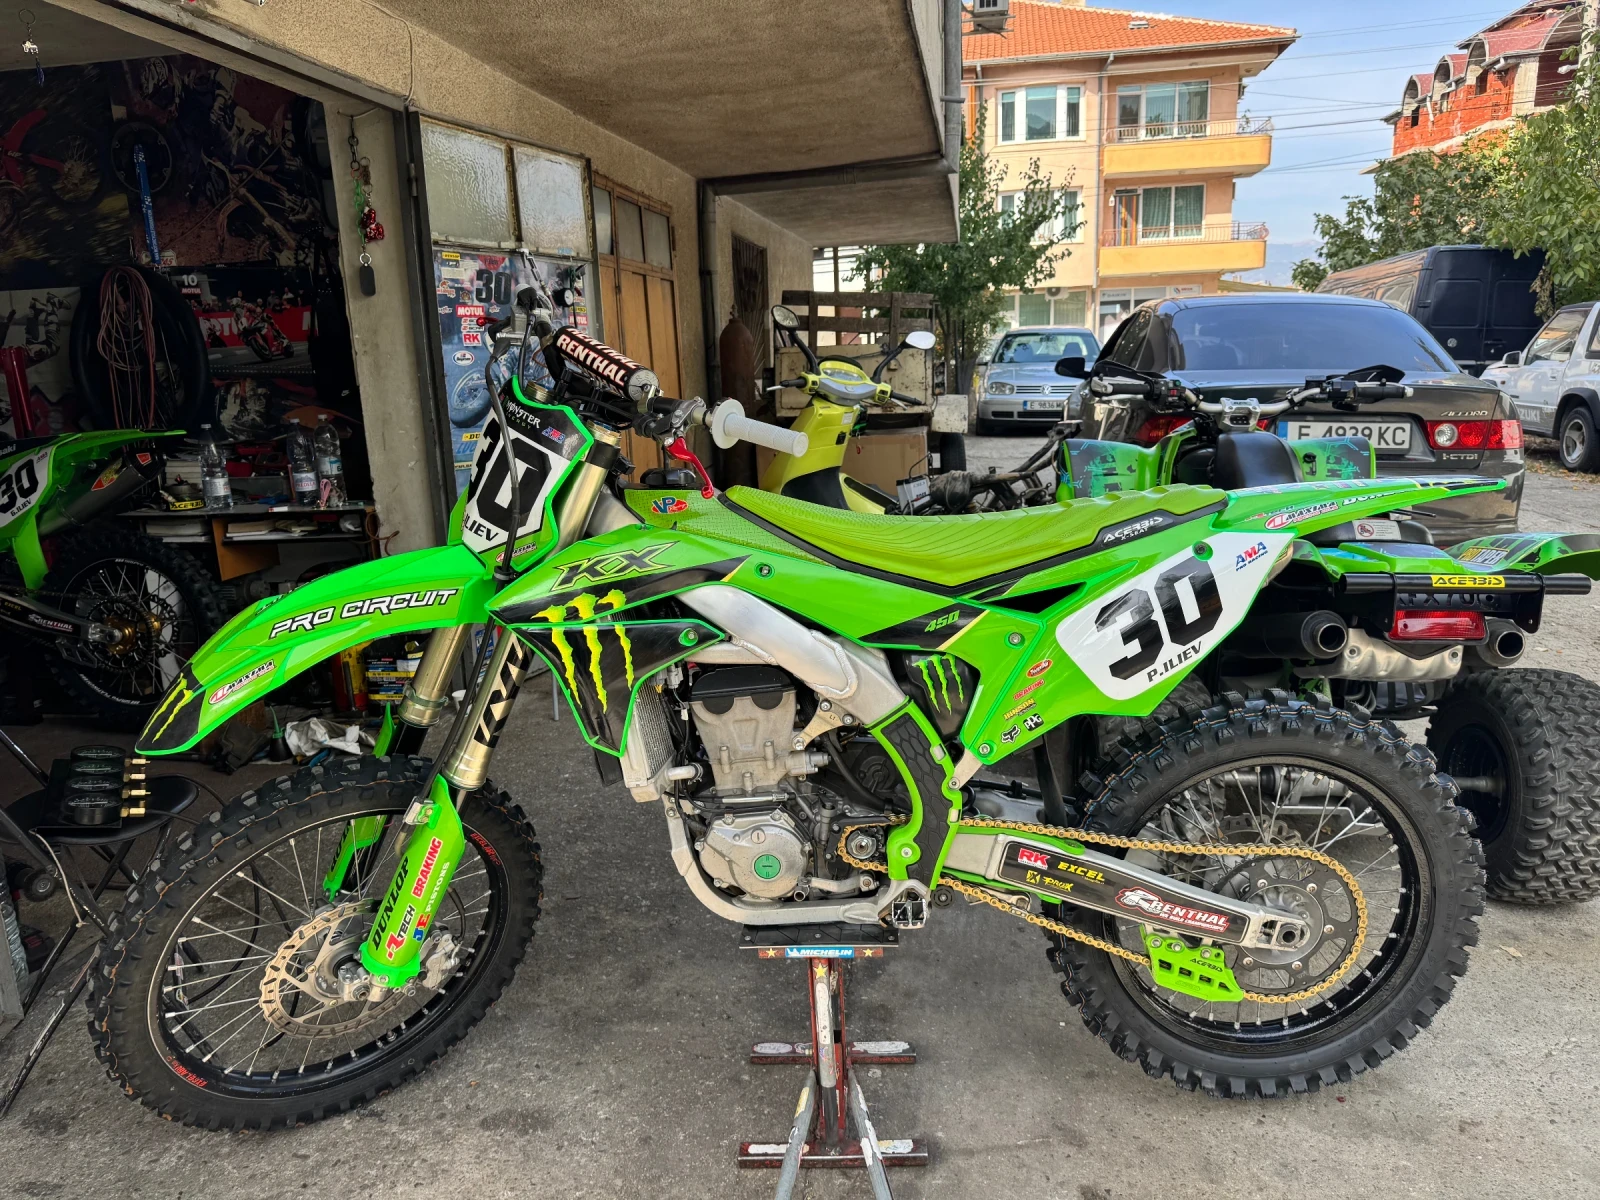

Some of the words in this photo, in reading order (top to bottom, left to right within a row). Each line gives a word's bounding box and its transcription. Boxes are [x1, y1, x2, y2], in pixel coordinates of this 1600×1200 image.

[182, 275, 198, 286] 10
[475, 269, 511, 305] 30
[457, 306, 484, 316] MOTUL
[569, 316, 587, 325] MTUL
[463, 333, 481, 343] RK
[556, 334, 627, 387] RENTHAL
[506, 400, 541, 429] MONSTER
[0, 458, 39, 514] 30
[651, 496, 676, 514] VP
[1285, 501, 1338, 522] MAXIMA
[1103, 516, 1164, 543] ACERBIS
[549, 540, 680, 592] KX
[1235, 541, 1267, 567] AMA
[1434, 577, 1503, 586] ACERBIS
[267, 606, 336, 640] PRO
[339, 588, 460, 620] CIRCUIT
[924, 609, 960, 633] 450
[1094, 556, 1223, 681] 30
[1146, 640, 1202, 683] P.ILIEV
[412, 836, 443, 899] BRAKING
[1018, 848, 1050, 867] RK
[1057, 861, 1106, 882] EXCEL
[425, 861, 450, 912] PISTONS
[372, 855, 410, 951] DUNLOP
[1150, 900, 1227, 926] RENTHAL
[412, 913, 432, 942] JE
[1190, 957, 1223, 973] ACERBIS
